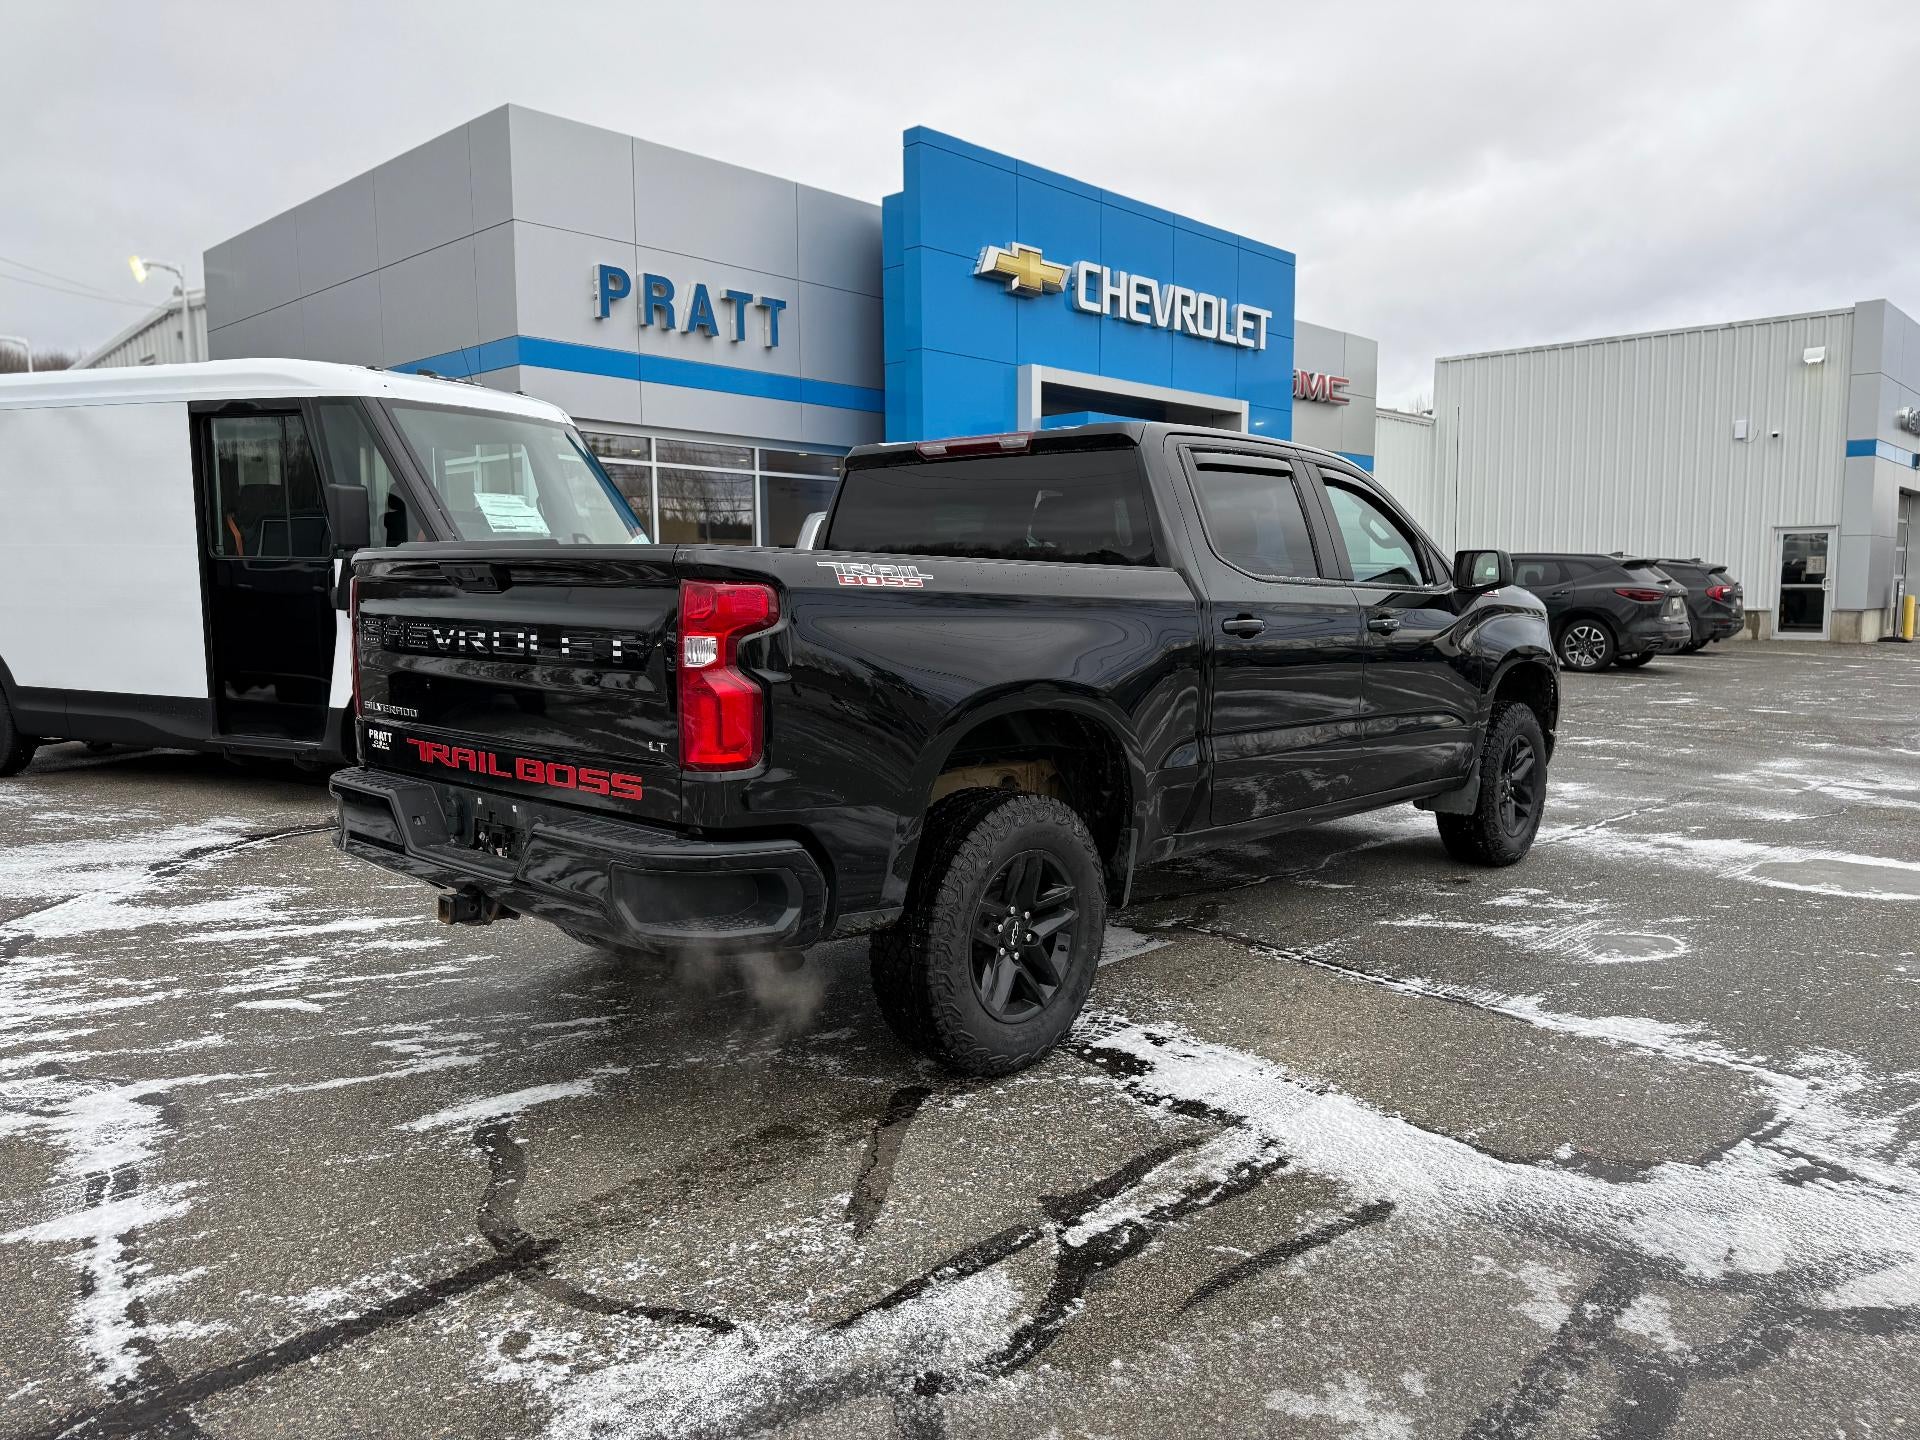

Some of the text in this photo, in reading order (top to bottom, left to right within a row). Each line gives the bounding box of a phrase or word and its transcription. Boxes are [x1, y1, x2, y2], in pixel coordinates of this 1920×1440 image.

[593, 263, 787, 348] PRATT
[1072, 260, 1273, 350] CHEVROLET
[816, 561, 934, 579] TRAIL
[837, 574, 924, 588] BOSS
[364, 700, 418, 718] SILVERADO
[368, 728, 392, 743] PRATT
[648, 741, 668, 753] LT
[406, 737, 643, 801] TRAIL BOSS
